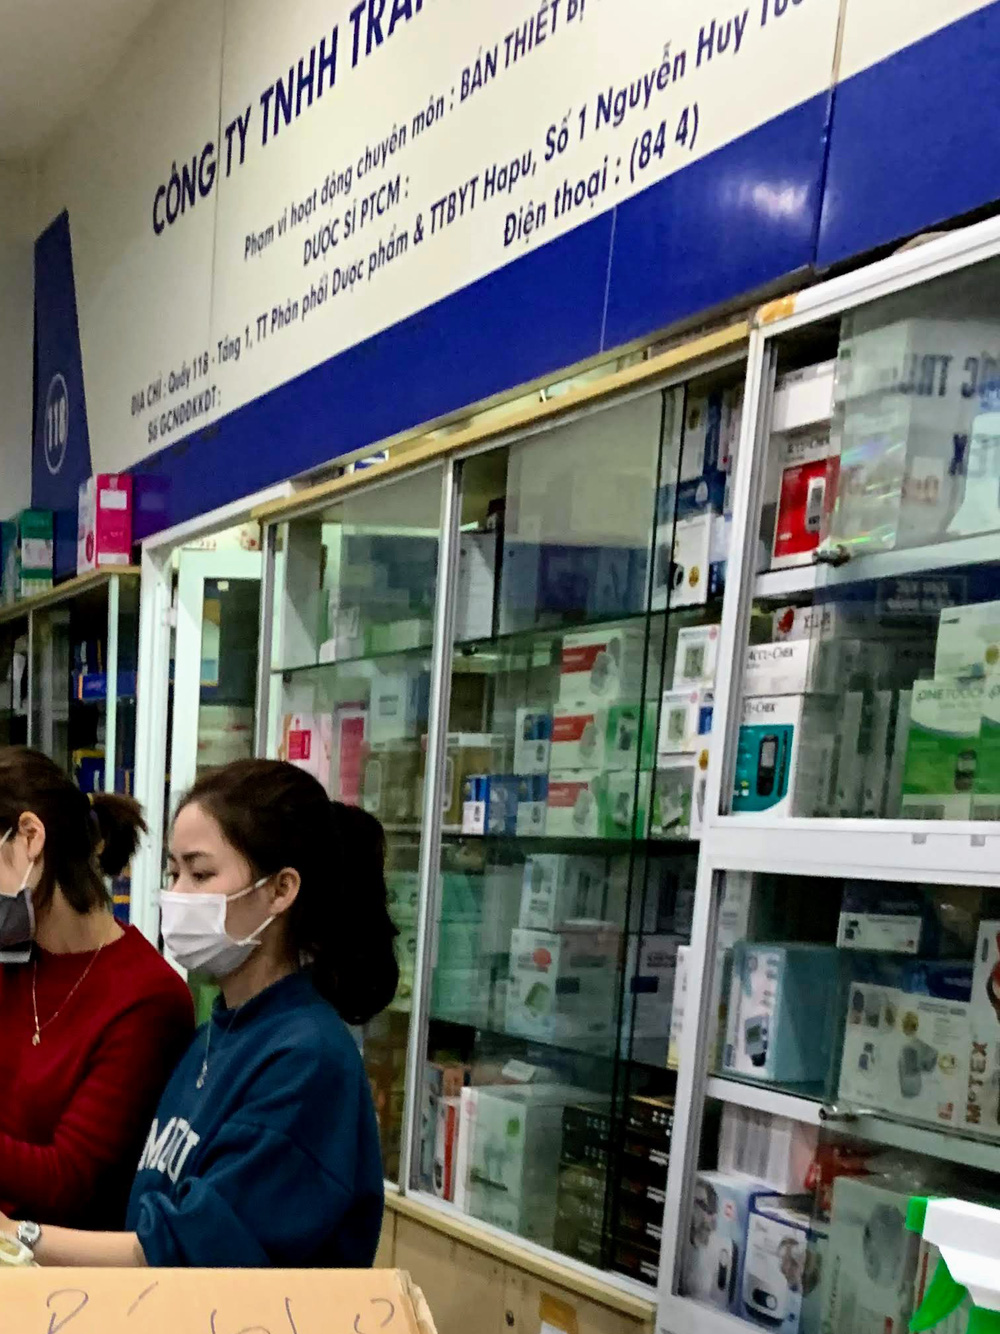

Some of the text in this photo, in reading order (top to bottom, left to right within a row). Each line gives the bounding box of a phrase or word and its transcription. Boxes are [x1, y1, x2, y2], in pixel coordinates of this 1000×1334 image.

[152, 0, 426, 235] CÔNG TY TNHH TRA
[193, 351, 210, 382] 118
[256, 313, 269, 342] TT
[368, 222, 409, 282] phẩm
[413, 212, 425, 245] &
[431, 176, 479, 235] TTBYT
[544, 107, 573, 163] Số
[577, 102, 588, 142] 1
[595, 39, 688, 132] Nguyễn
[696, 8, 750, 68] Huy
[290, 188, 318, 225] hoạt
[320, 165, 354, 208] động
[355, 122, 407, 181] chuyên
[412, 94, 445, 140] môn
[460, 46, 498, 104] BÁN
[503, 200, 548, 248] Điện
[554, 154, 609, 221] thoại
[303, 218, 341, 268] DƯỢC
[360, 173, 402, 229] PTCM
